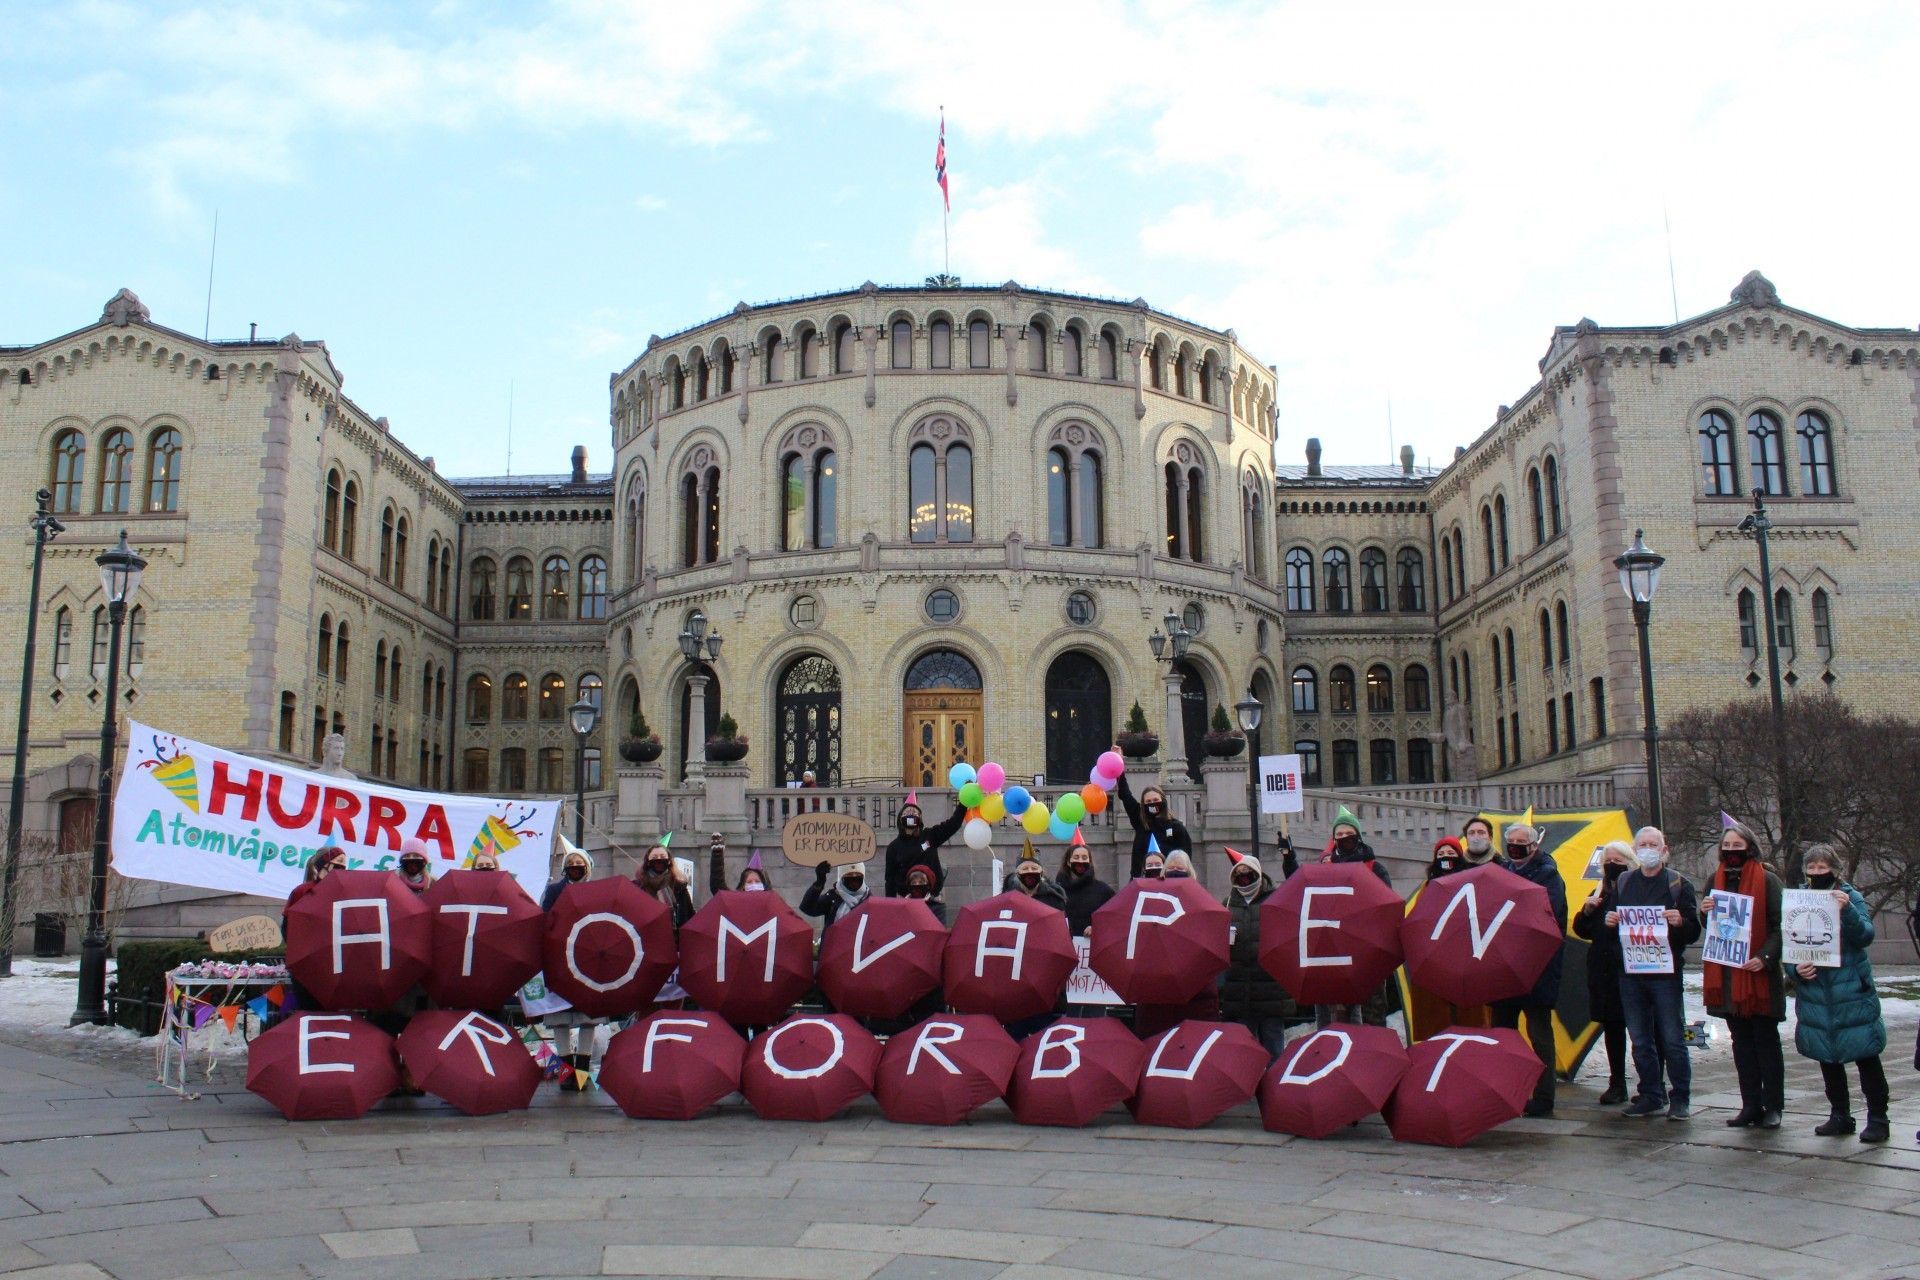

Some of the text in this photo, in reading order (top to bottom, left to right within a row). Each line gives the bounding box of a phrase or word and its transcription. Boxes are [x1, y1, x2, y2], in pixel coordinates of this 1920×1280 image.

[207, 760, 456, 861] HURRA
[795, 838, 811, 851] ER
[1619, 908, 1664, 926] NORGE
[1629, 925, 1661, 946] MÅ
[1626, 945, 1669, 963] SIGNERE
[1067, 974, 1091, 994] MOT
